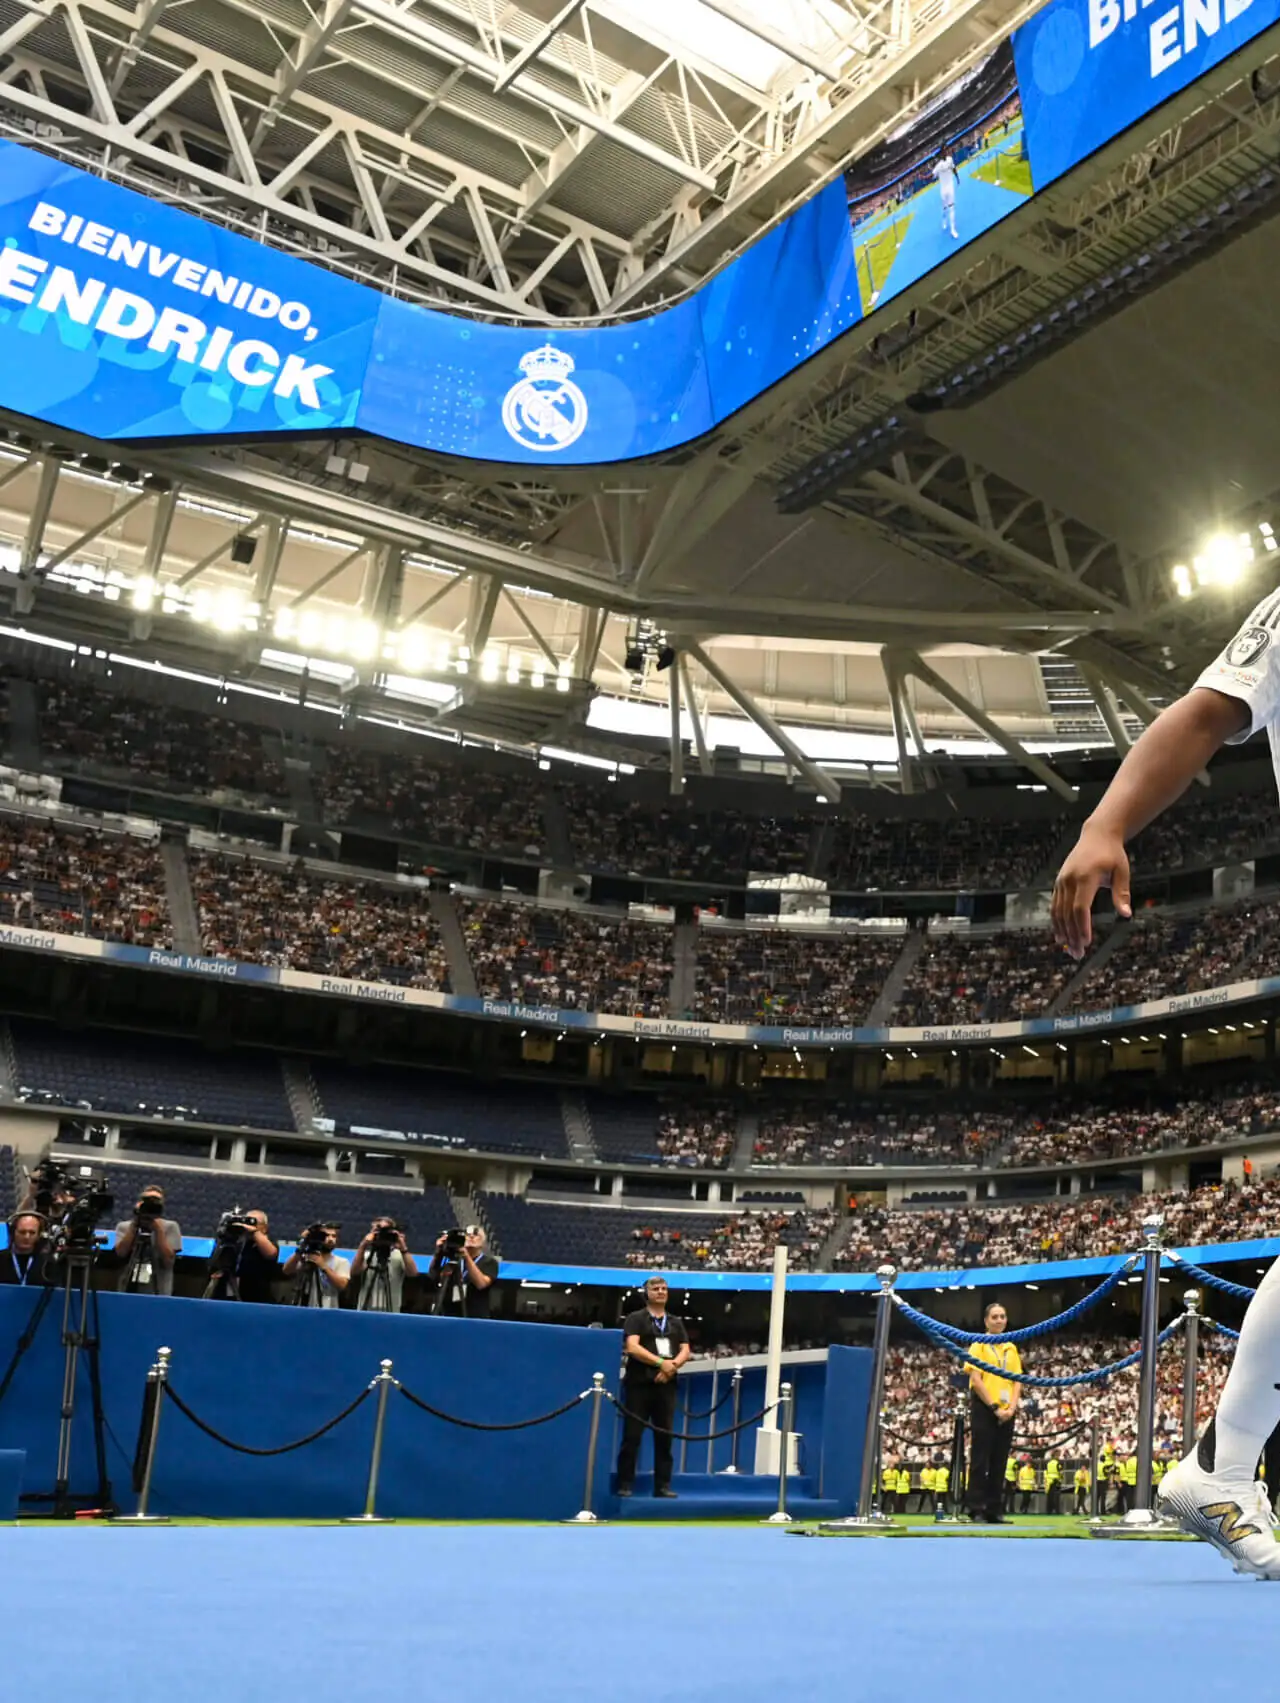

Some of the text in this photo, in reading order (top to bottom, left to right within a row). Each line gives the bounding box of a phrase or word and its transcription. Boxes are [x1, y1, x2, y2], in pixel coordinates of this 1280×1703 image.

[28, 201, 319, 341] BIENVENIDO,
[0, 247, 335, 409] ENDRICK
[149, 951, 238, 976] Real Madrid
[321, 979, 406, 1001] Real Madrid
[483, 1001, 559, 1022] Real Madrid
[1168, 991, 1229, 1013] Real Madrid
[633, 1021, 710, 1037] Real Madrid
[1054, 1012, 1112, 1030] Real Madrid
[783, 1028, 853, 1041] Real Madrid
[922, 1028, 992, 1041] Real Madrid
